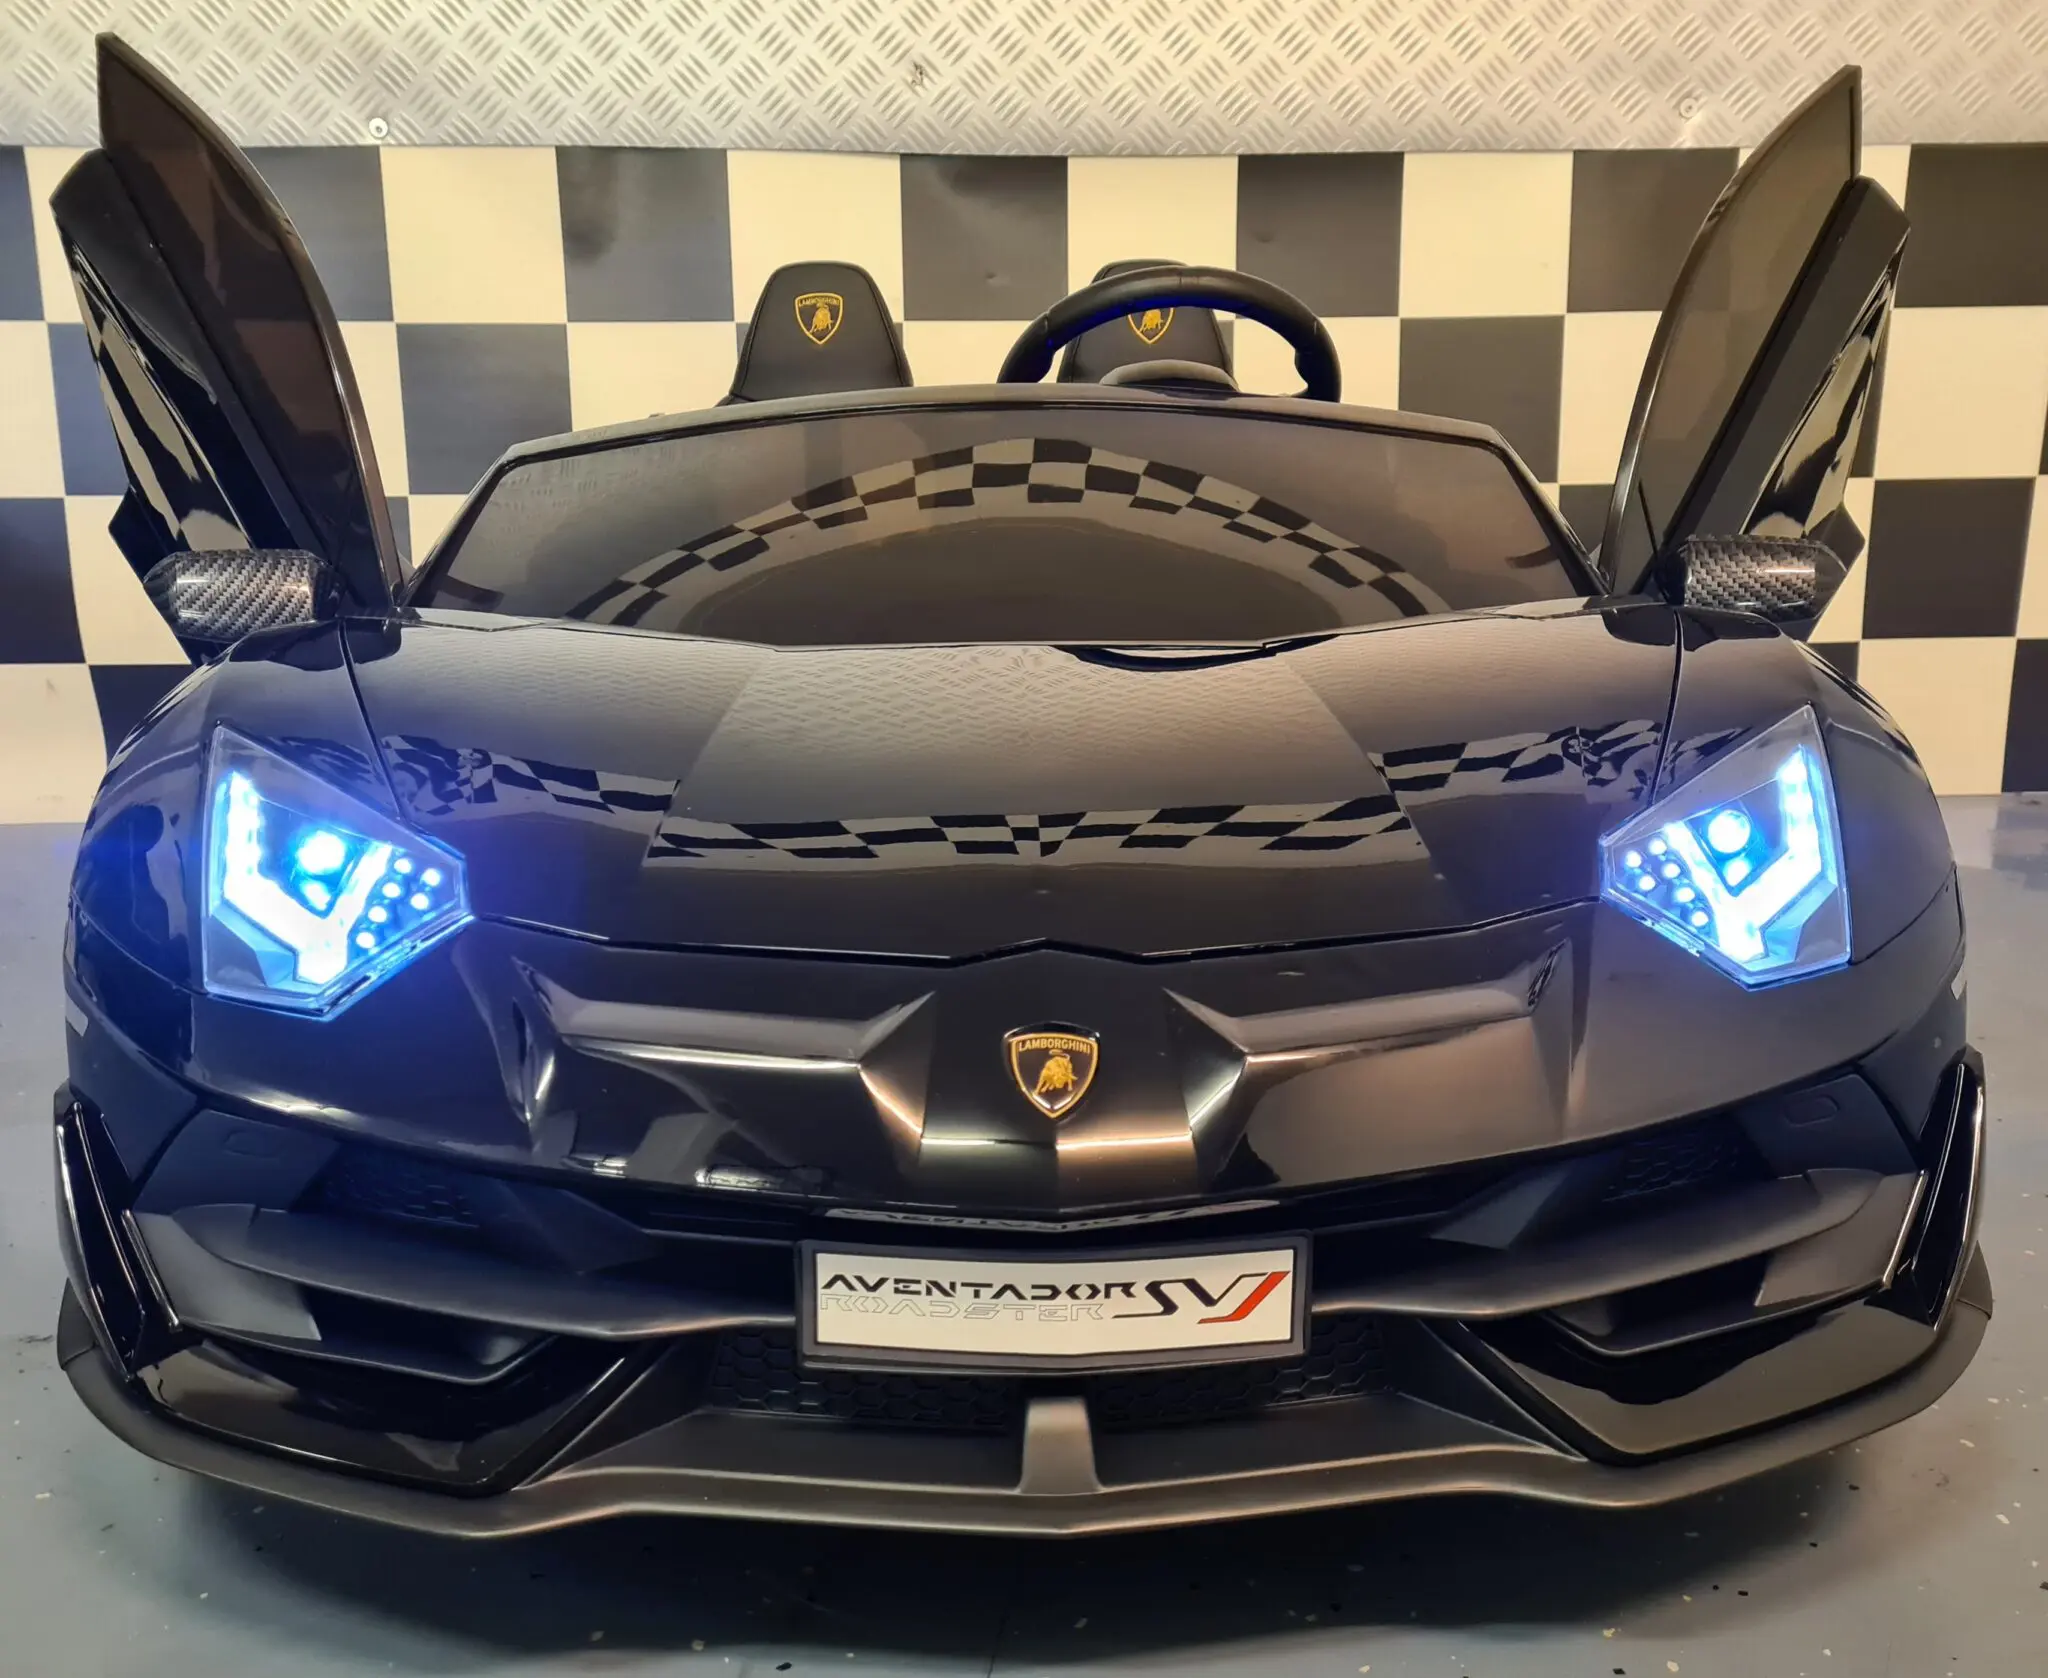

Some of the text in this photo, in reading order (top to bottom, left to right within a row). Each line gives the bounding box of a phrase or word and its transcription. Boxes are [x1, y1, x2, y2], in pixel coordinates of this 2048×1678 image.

[1018, 1038, 1091, 1054] LAMBORGHINI
[821, 1274, 1137, 1301] AVENTADOR
[820, 1294, 1104, 1321] ROADSTER
